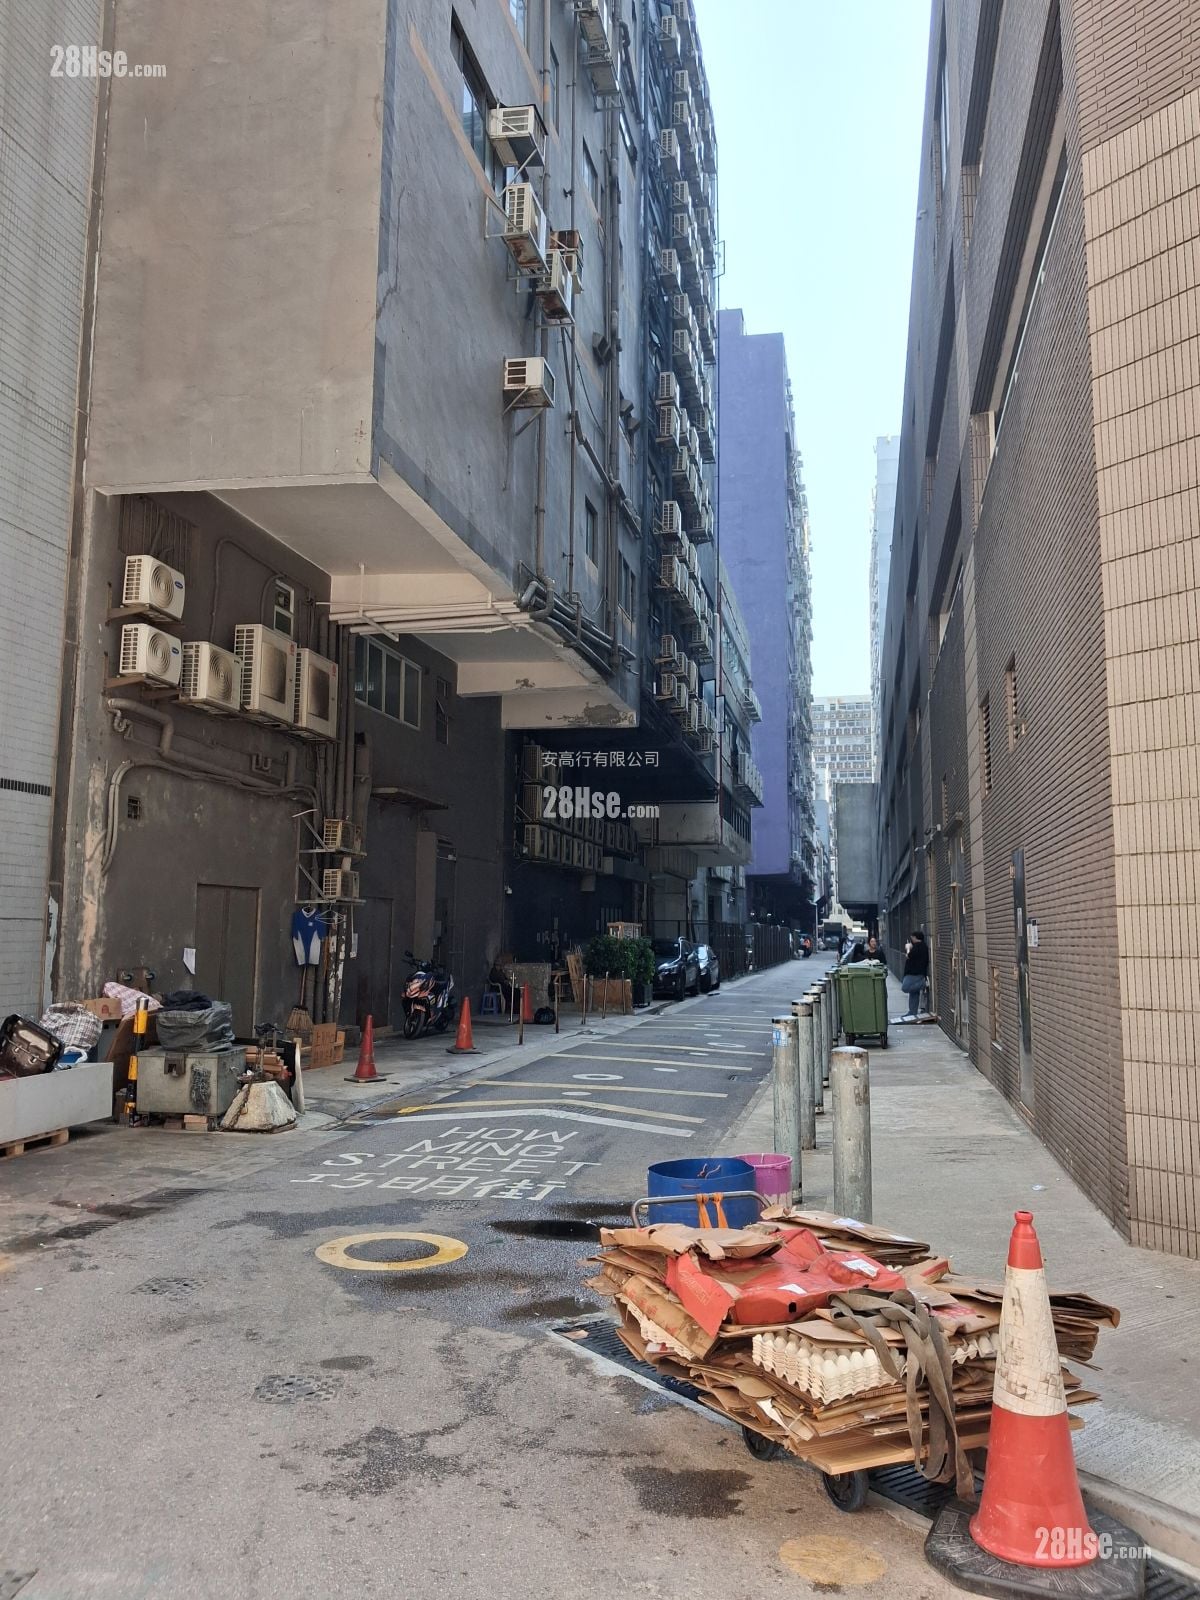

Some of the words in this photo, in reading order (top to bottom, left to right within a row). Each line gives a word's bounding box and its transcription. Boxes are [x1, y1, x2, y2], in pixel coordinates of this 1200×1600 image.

[438, 1126, 579, 1143] HOW
[404, 1139, 564, 1157] MING
[322, 1152, 601, 1176] STREET
[290, 1171, 567, 1200] 巧明街
